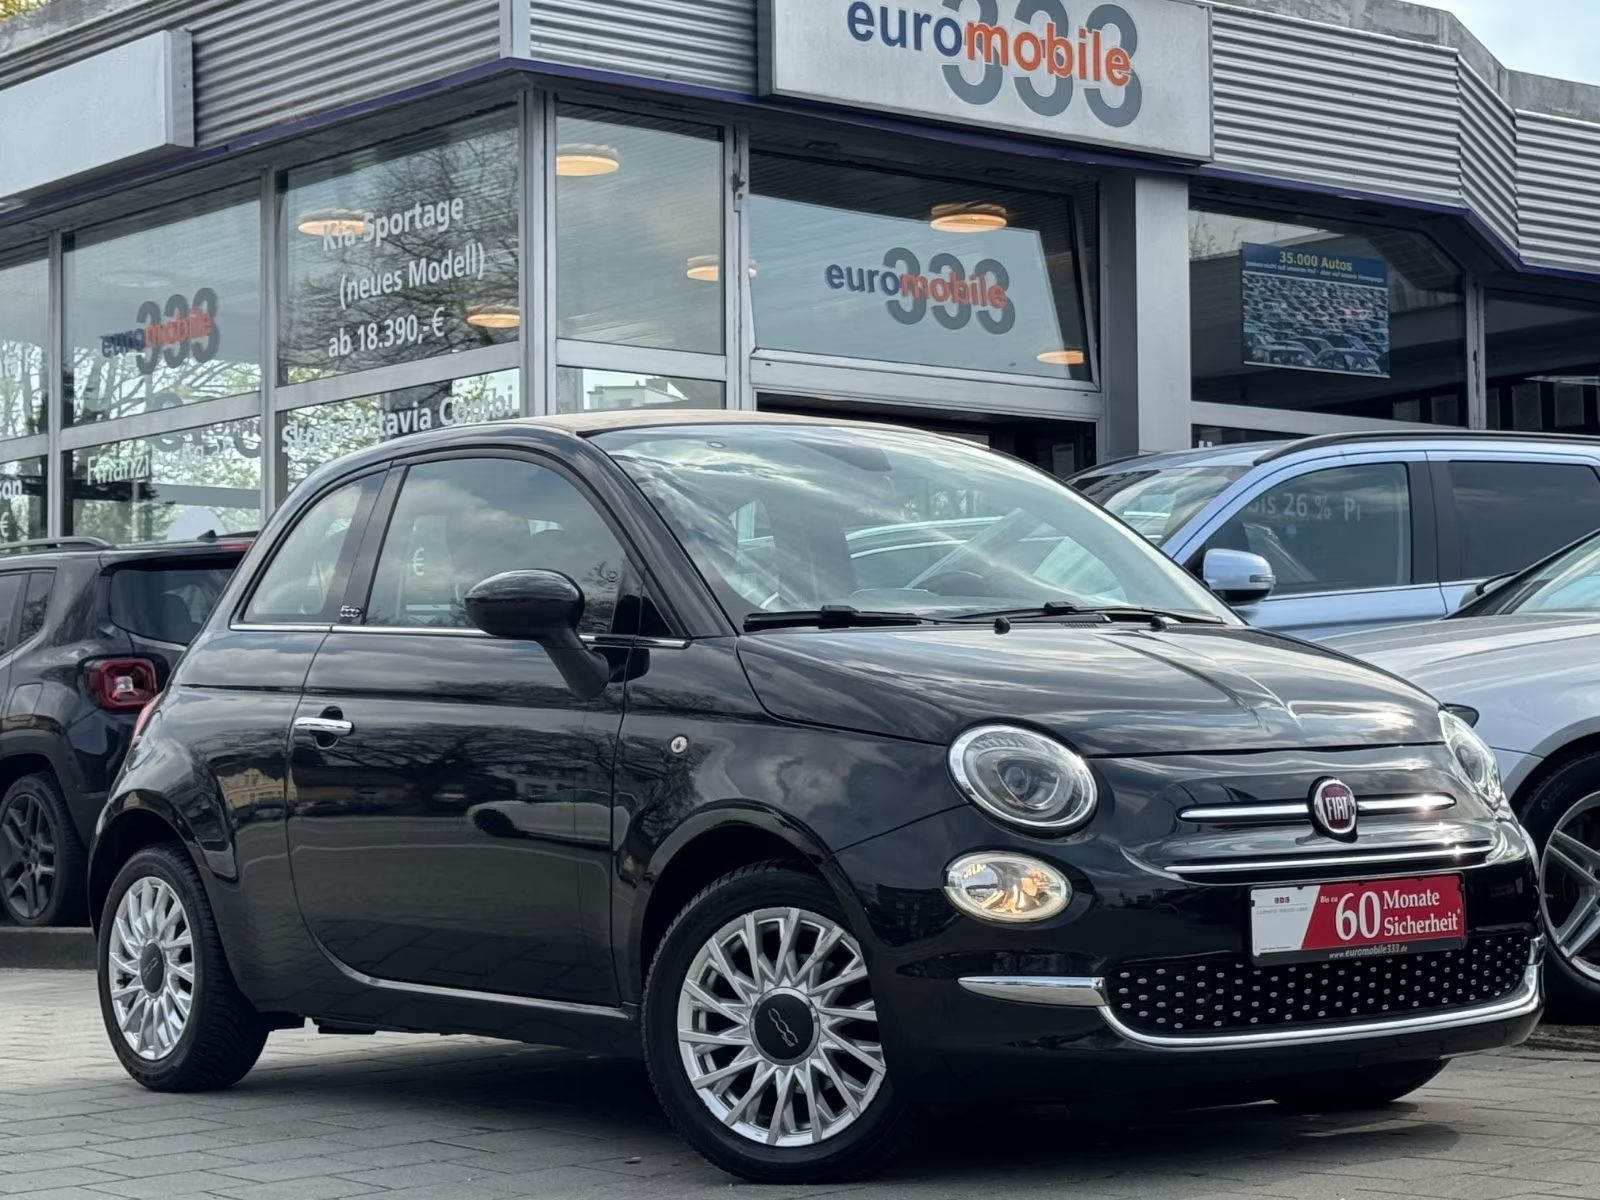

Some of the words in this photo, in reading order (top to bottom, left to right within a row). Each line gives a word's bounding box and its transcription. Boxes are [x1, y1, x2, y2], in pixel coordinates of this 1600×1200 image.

[847, 1, 1131, 87] euromobile
[941, 0, 1142, 128] 333
[322, 219, 356, 250] Kia
[364, 197, 464, 247] Sportage
[339, 270, 402, 309] (neues
[408, 242, 485, 288] Modell)
[1279, 251, 1318, 267] 35.000
[1321, 257, 1353, 272] Autos
[825, 263, 1007, 309] euromobile
[883, 247, 1016, 335] 333
[328, 328, 351, 357] ab
[0, 479, 22, 500] on
[1283, 492, 1308, 517] 26
[1314, 493, 1332, 520] %
[412, 547, 425, 577] €
[1325, 797, 1349, 820] FIAT
[1383, 889, 1440, 910] Monate
[1335, 891, 1381, 941] 60
[1329, 943, 1408, 959] www.euromobile333.de
